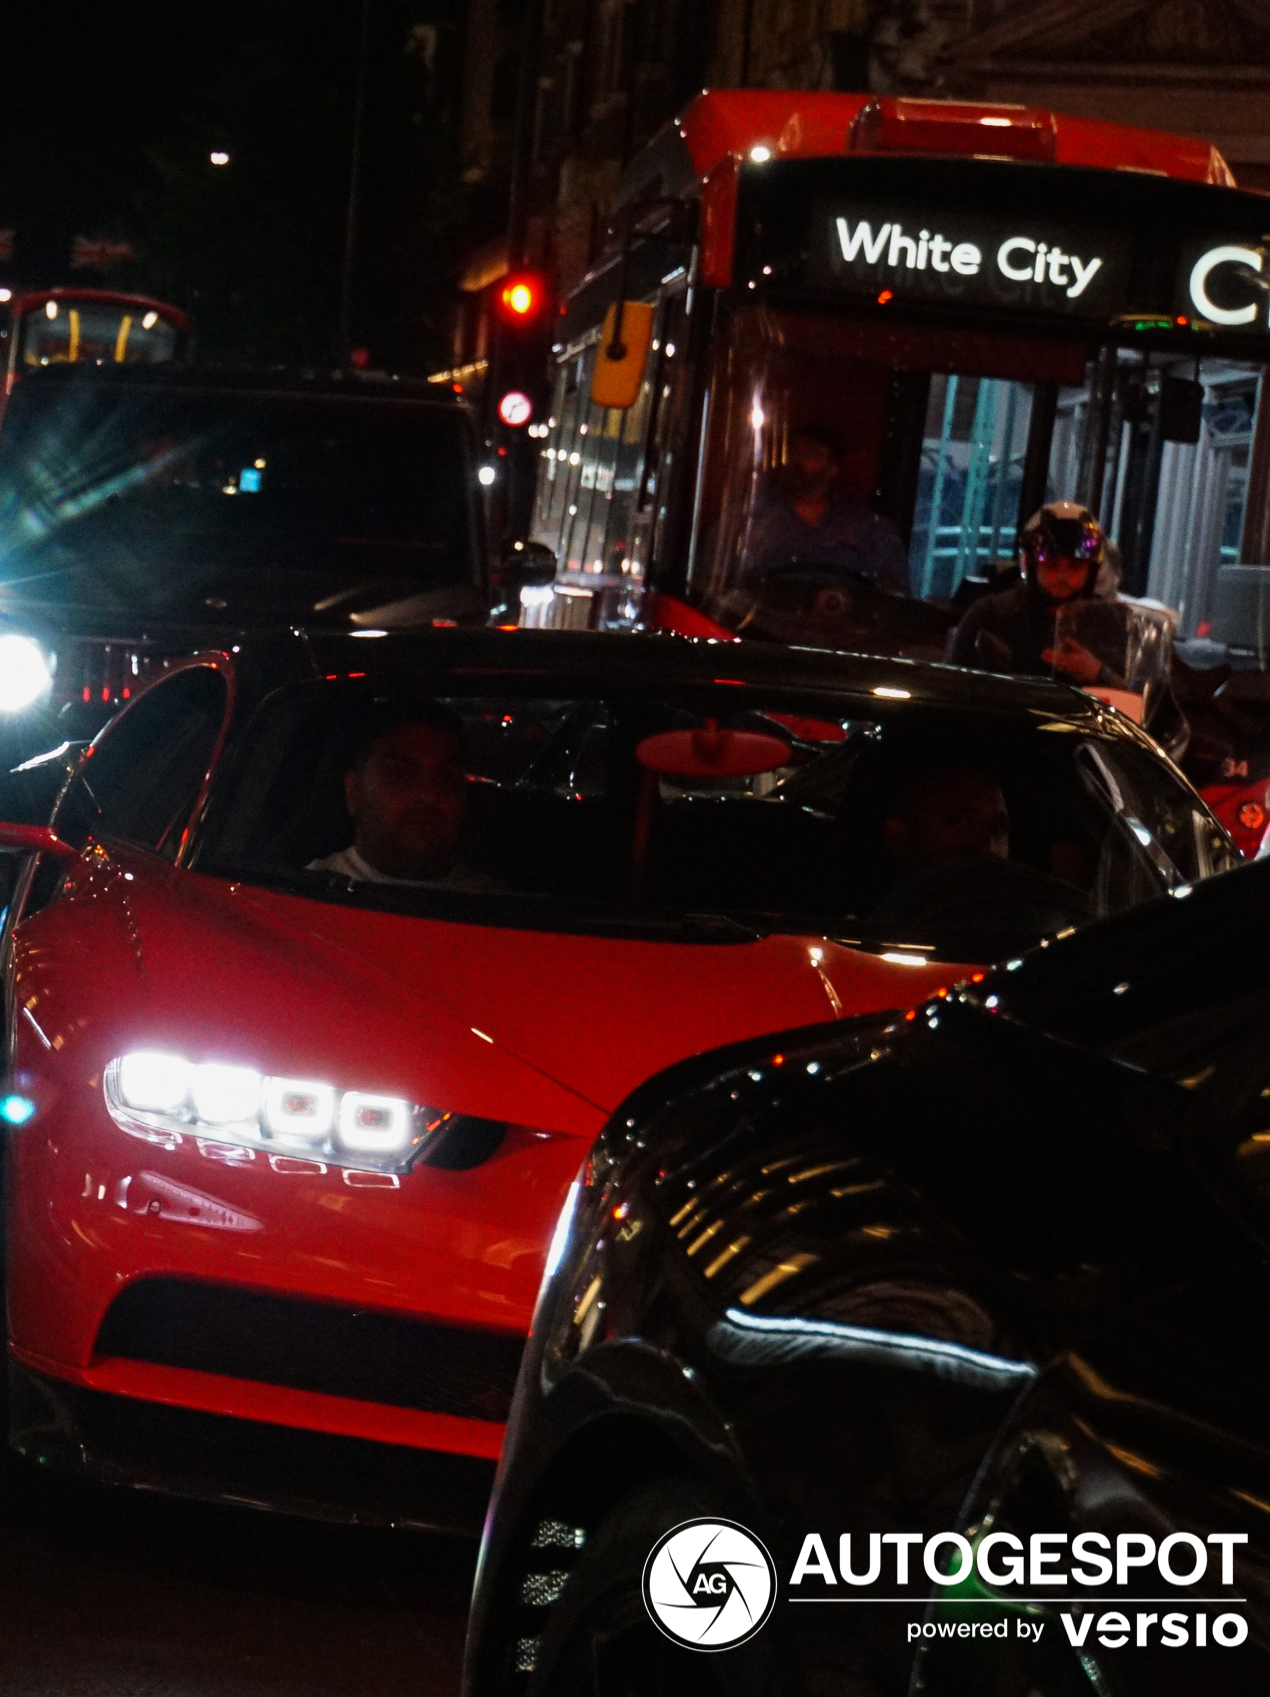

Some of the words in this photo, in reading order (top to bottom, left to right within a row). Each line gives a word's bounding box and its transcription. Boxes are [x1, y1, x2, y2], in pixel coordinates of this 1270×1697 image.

[836, 217, 982, 275] White
[997, 236, 1102, 298] City
[1189, 246, 1270, 327] C
